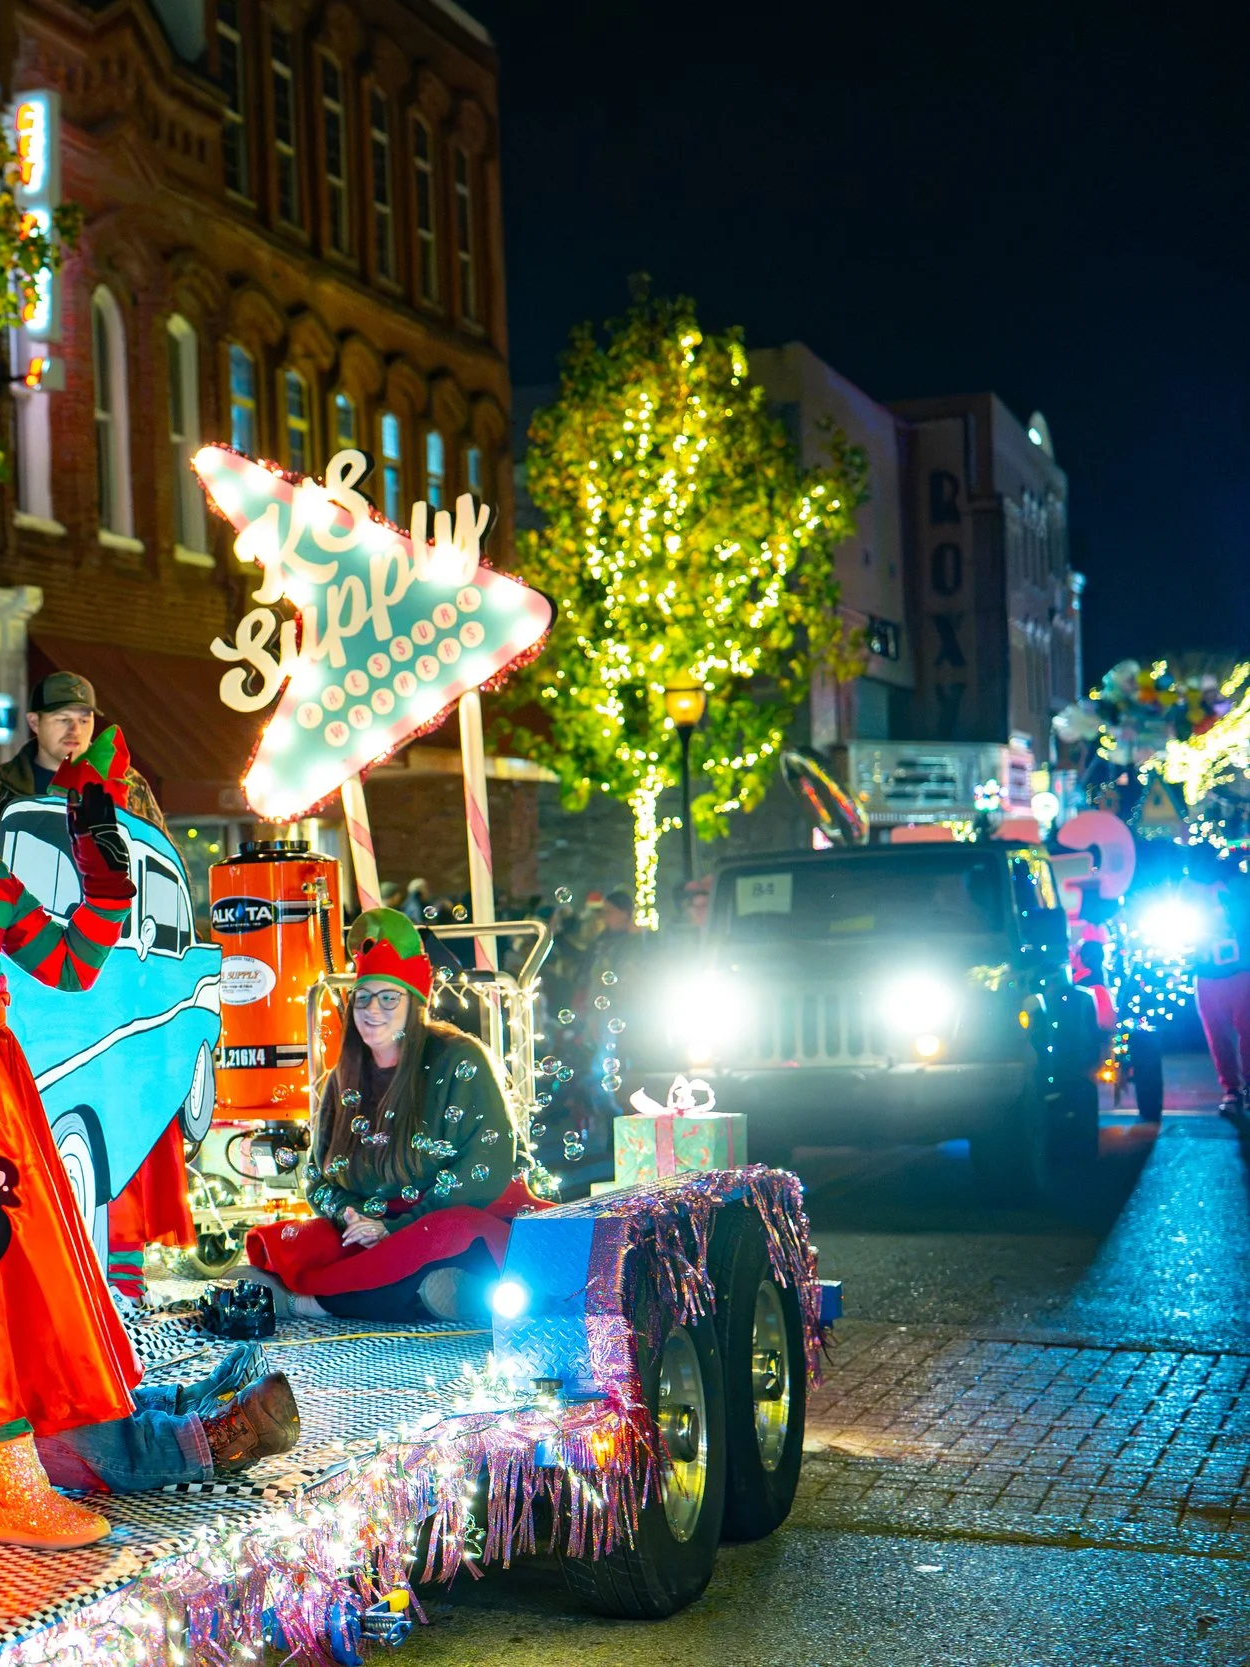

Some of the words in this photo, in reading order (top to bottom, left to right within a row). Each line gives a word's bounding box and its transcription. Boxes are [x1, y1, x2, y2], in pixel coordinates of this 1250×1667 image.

[210, 492, 491, 713] Supply
[301, 590, 477, 724] PRESSURE
[328, 624, 481, 742] WASHERS
[929, 468, 967, 739] ROXY
